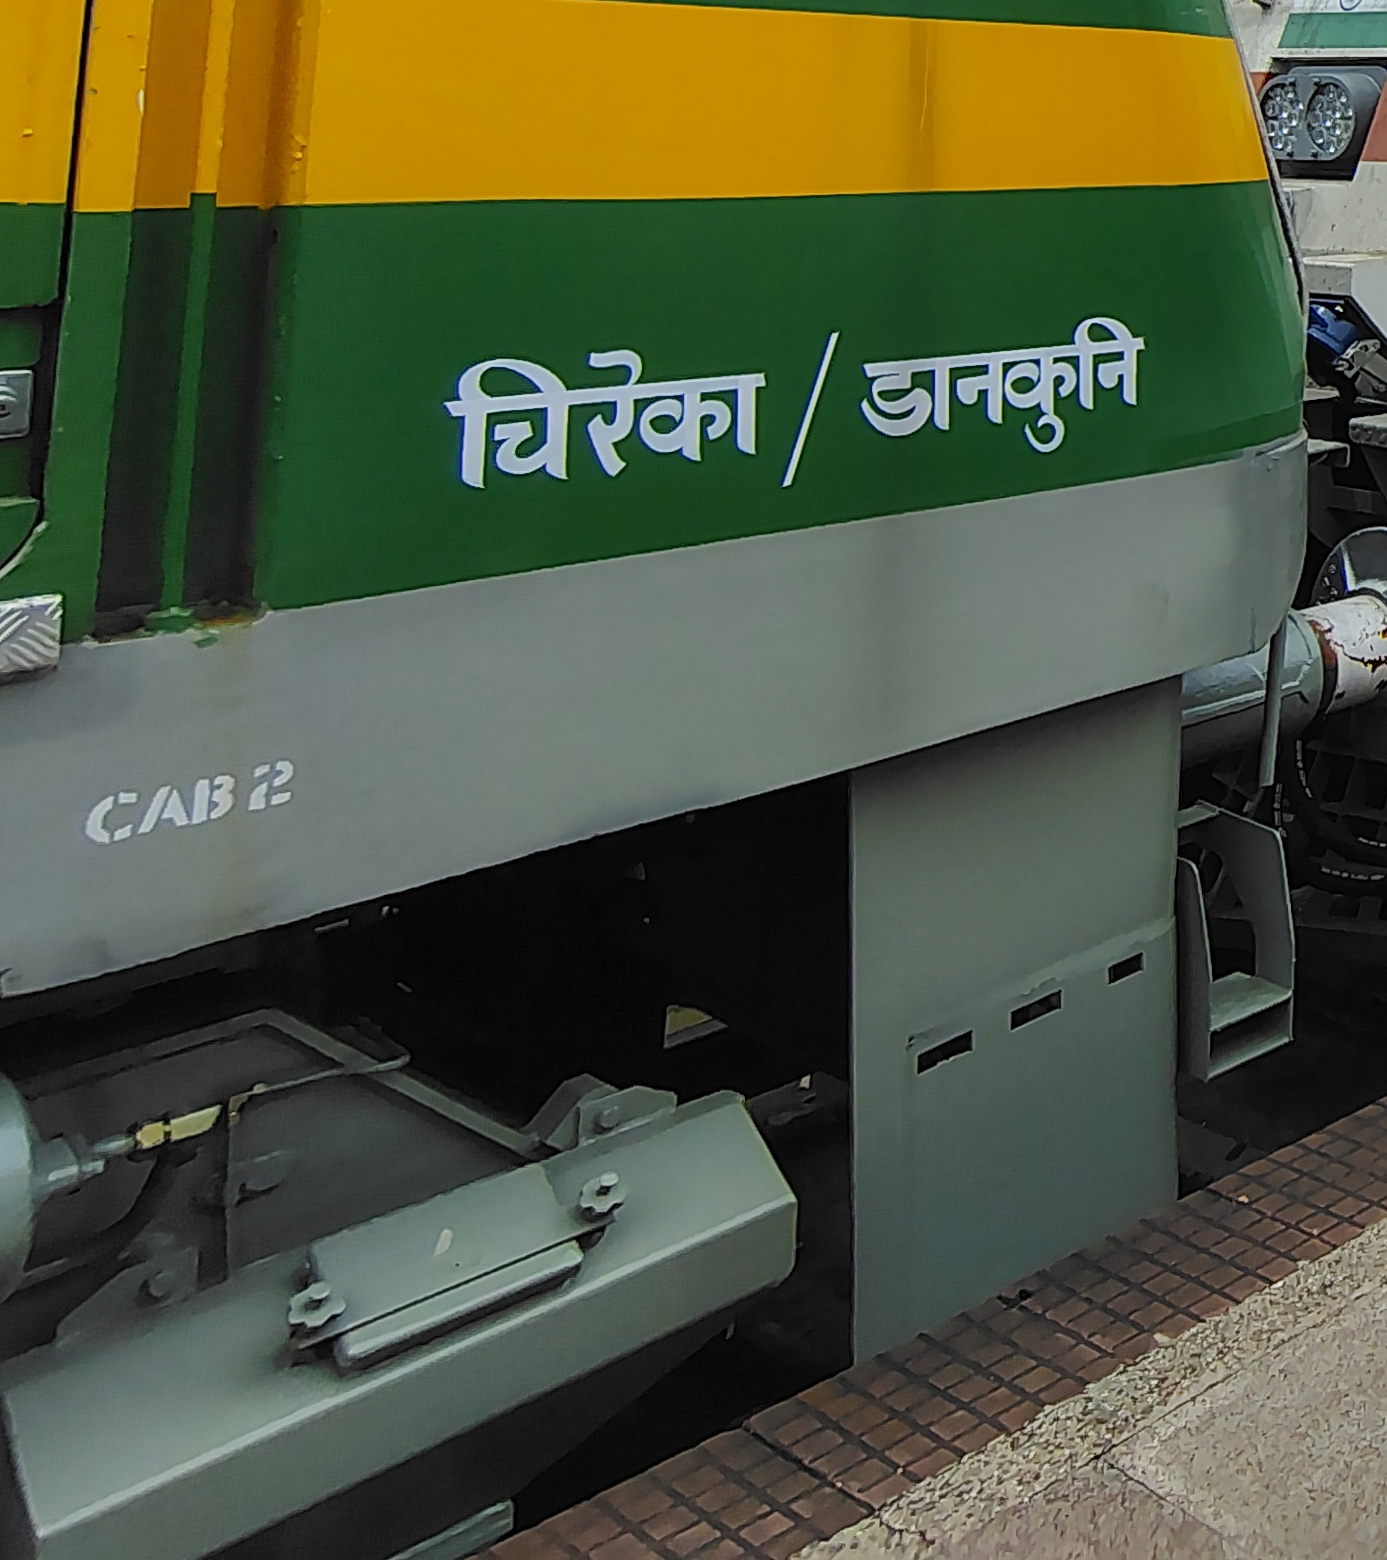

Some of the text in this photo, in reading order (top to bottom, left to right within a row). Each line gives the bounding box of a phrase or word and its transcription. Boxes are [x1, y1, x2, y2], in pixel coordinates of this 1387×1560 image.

[444, 316, 1146, 490] चिरेका / डानकुनि
[85, 759, 294, 844] CAB 2
